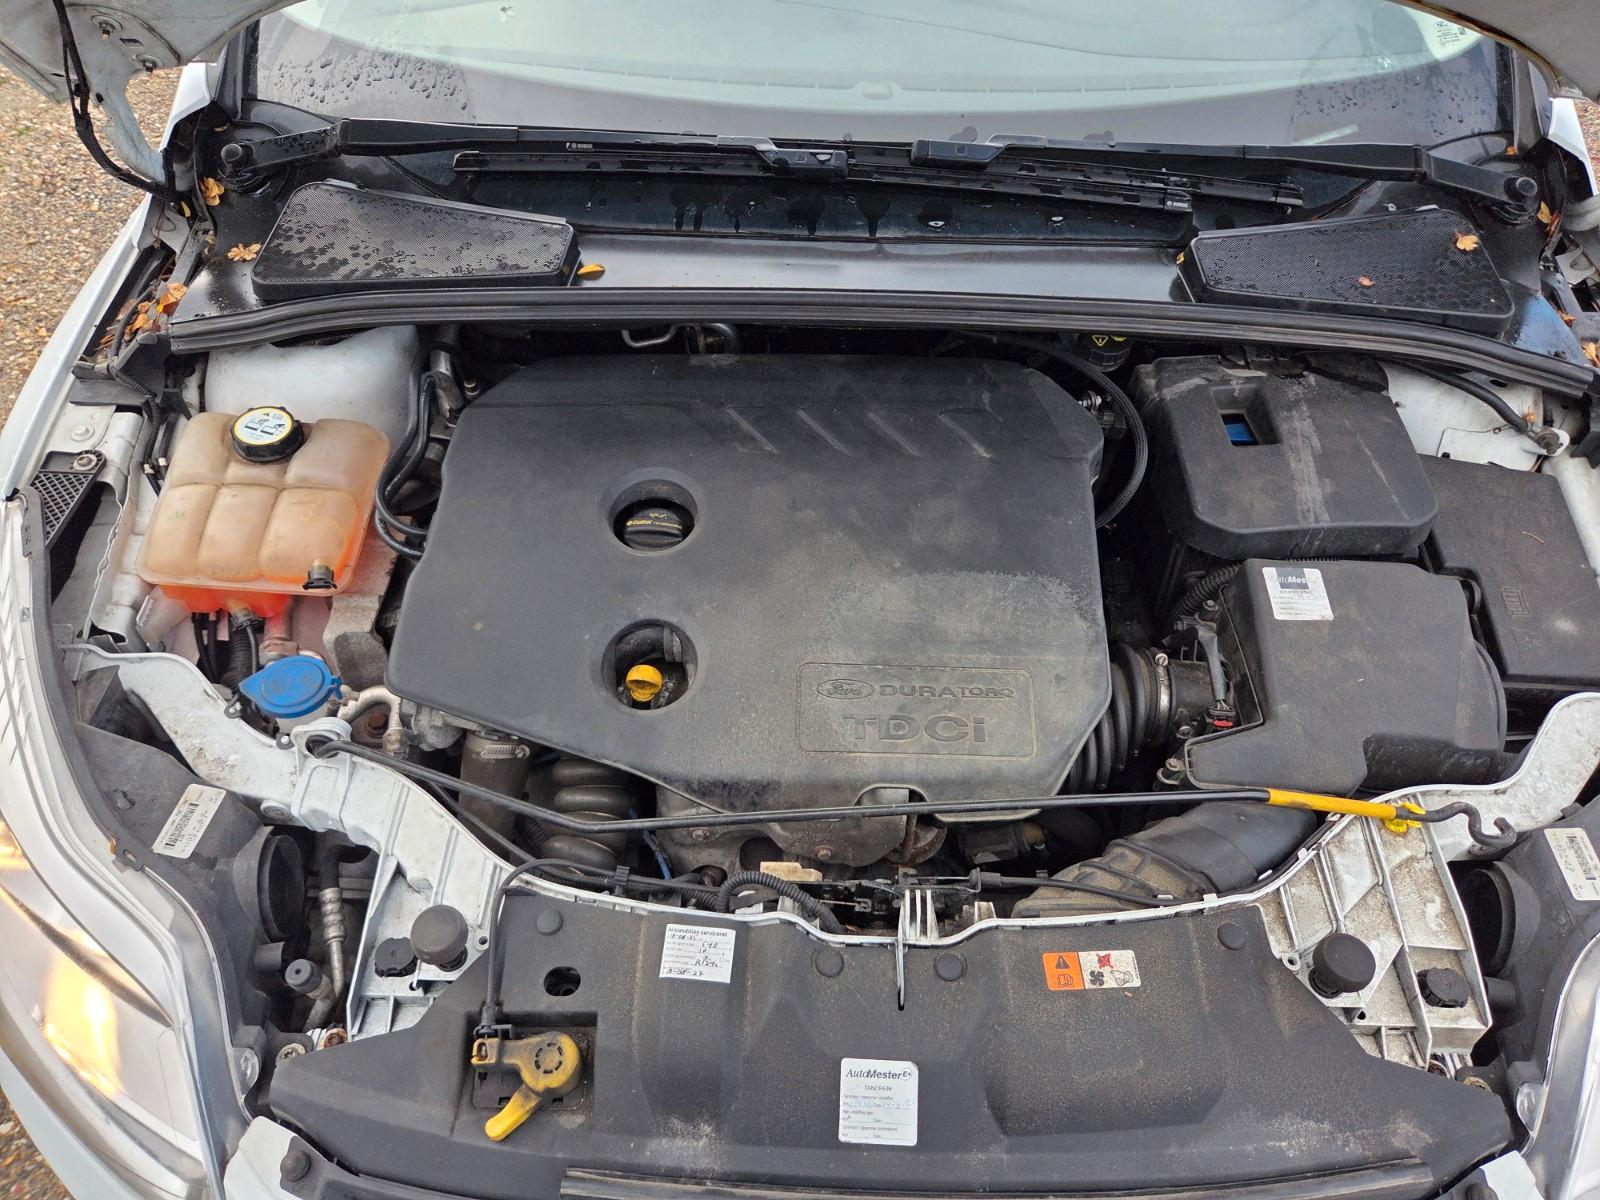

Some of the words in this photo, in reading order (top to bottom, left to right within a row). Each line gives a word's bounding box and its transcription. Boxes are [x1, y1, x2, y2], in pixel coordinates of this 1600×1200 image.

[825, 680, 866, 697] Ford
[878, 684, 1015, 699] DURATORQ
[842, 714, 986, 743] TDCi
[846, 1068, 902, 1080] AutoMester
